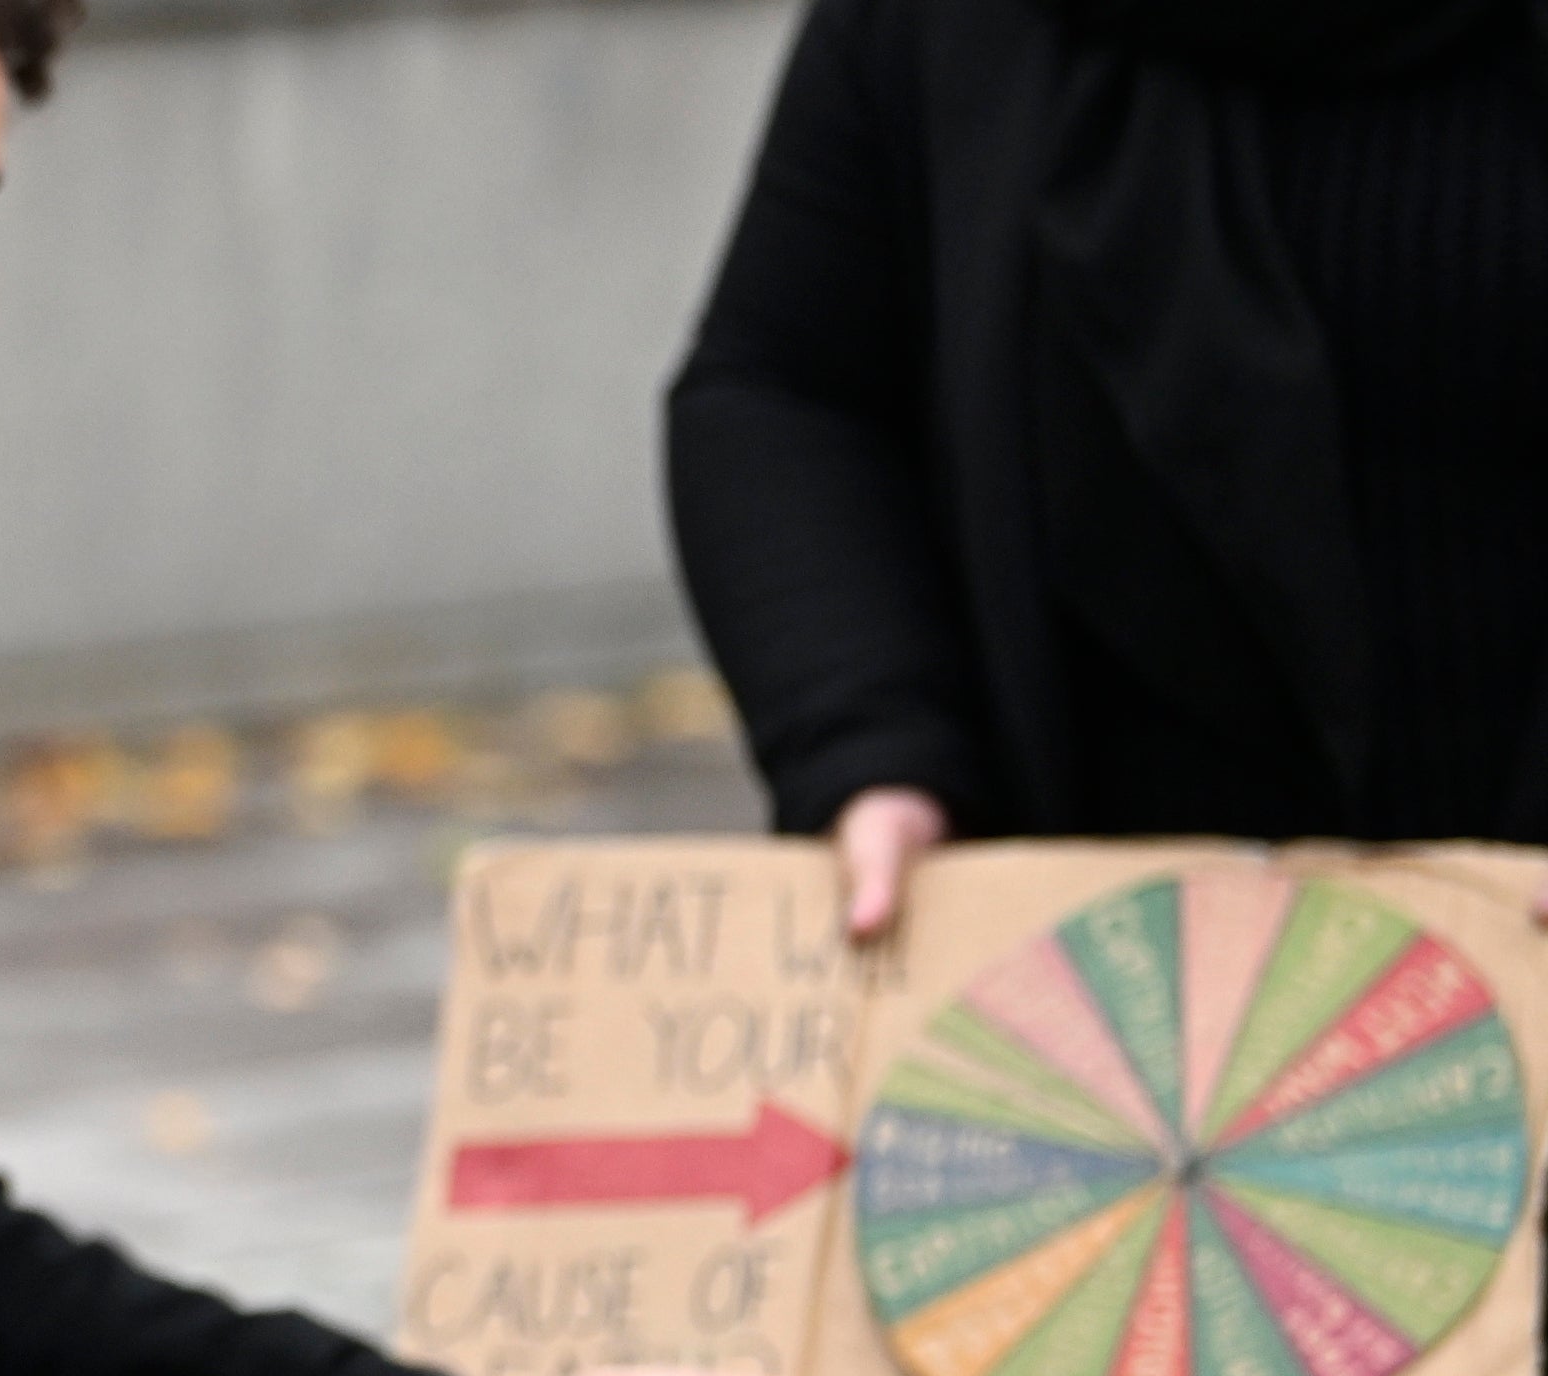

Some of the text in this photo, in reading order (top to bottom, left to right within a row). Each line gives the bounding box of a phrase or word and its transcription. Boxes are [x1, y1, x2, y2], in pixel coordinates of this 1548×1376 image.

[468, 866, 730, 984] WHAT
[464, 986, 858, 1106] BE YOUR
